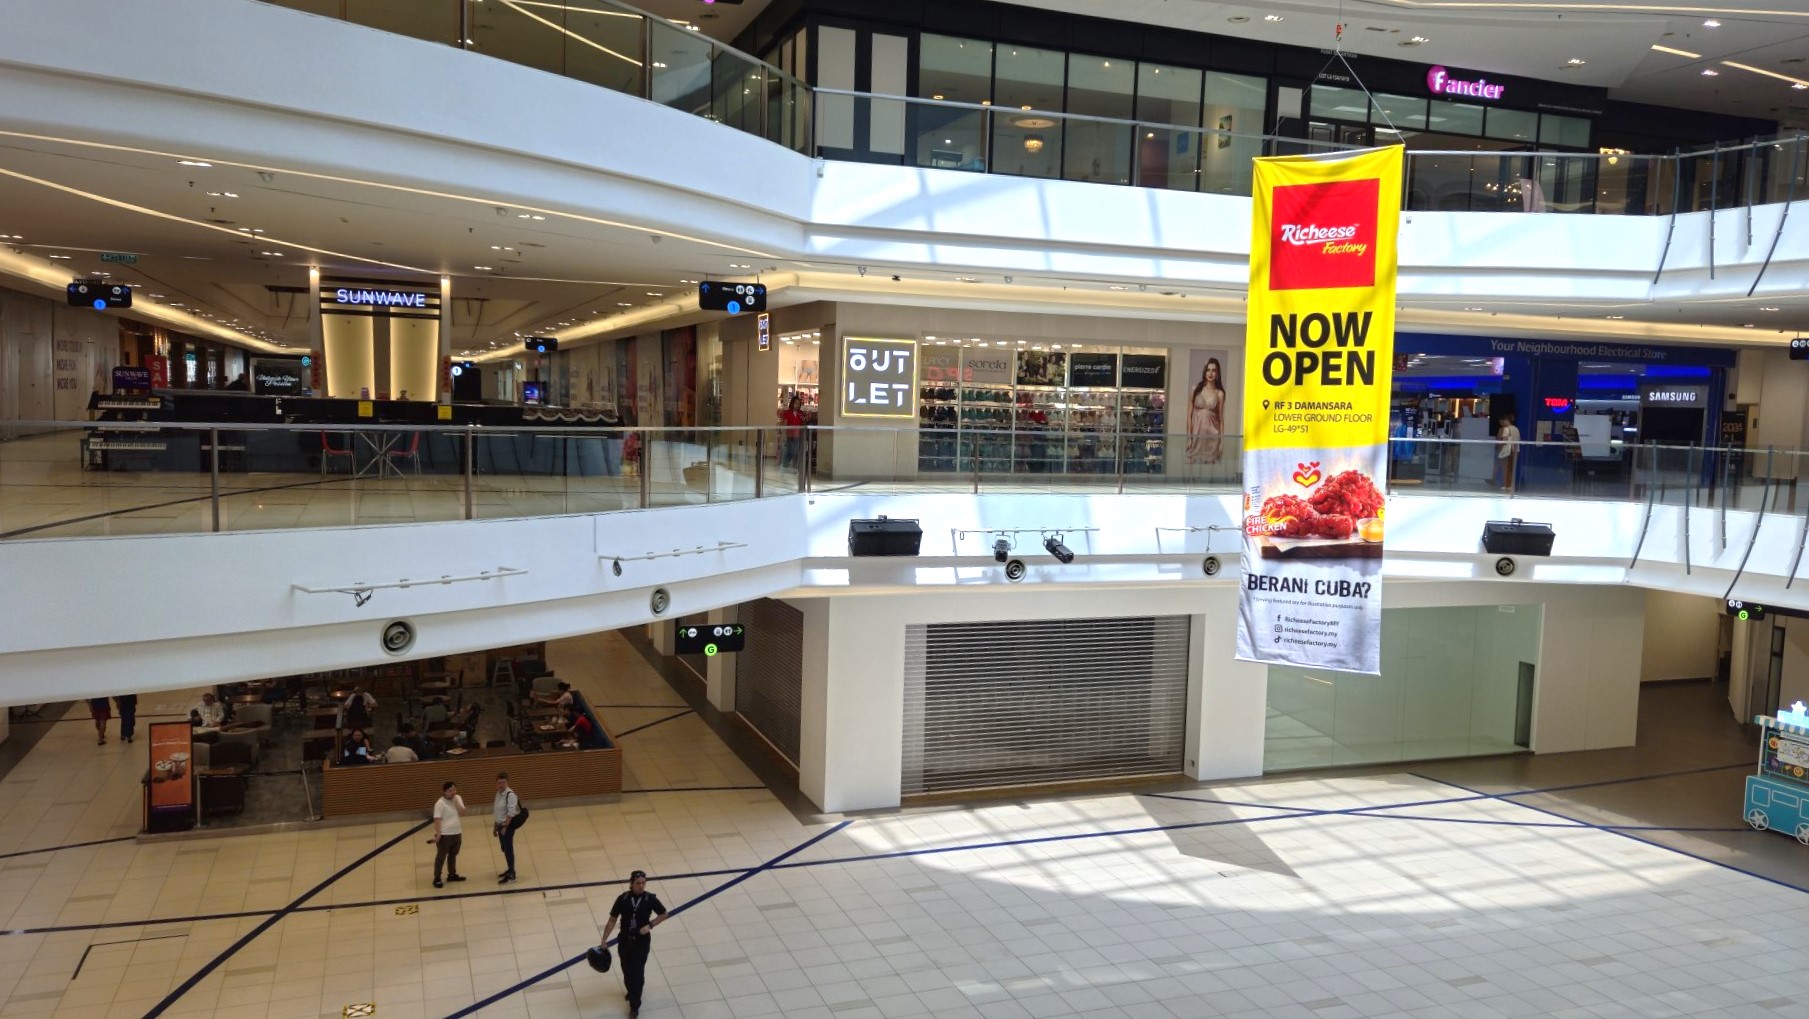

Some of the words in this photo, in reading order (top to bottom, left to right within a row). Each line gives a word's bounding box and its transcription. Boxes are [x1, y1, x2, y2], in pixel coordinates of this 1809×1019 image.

[1281, 224, 1356, 244] Richeese
[1322, 242, 1367, 256] Factory
[337, 289, 426, 307] SUNWAVE
[1270, 311, 1373, 348] NOW
[1491, 340, 1515, 351] Your
[1517, 341, 1597, 356] Neighbourhood
[1598, 345, 1641, 358] Electrical
[1642, 348, 1667, 359] Store
[849, 348, 910, 374] OUT
[1262, 350, 1375, 386] OPEN
[115, 370, 149, 378] SUNWAVE
[848, 382, 909, 407] LET
[1545, 398, 1568, 407] TBM
[1649, 392, 1696, 401] SAMSUNG
[1274, 401, 1285, 409] RF
[1294, 401, 1352, 410] DAMANSARA
[1273, 413, 1302, 422] LOWER
[1304, 413, 1342, 422] GROUND
[1344, 413, 1372, 422] FLOOR
[1245, 523, 1287, 534] CHICKEN
[1246, 516, 1266, 526] FIRE
[1247, 573, 1308, 594] BERANI
[1315, 579, 1372, 599] CUBA?
